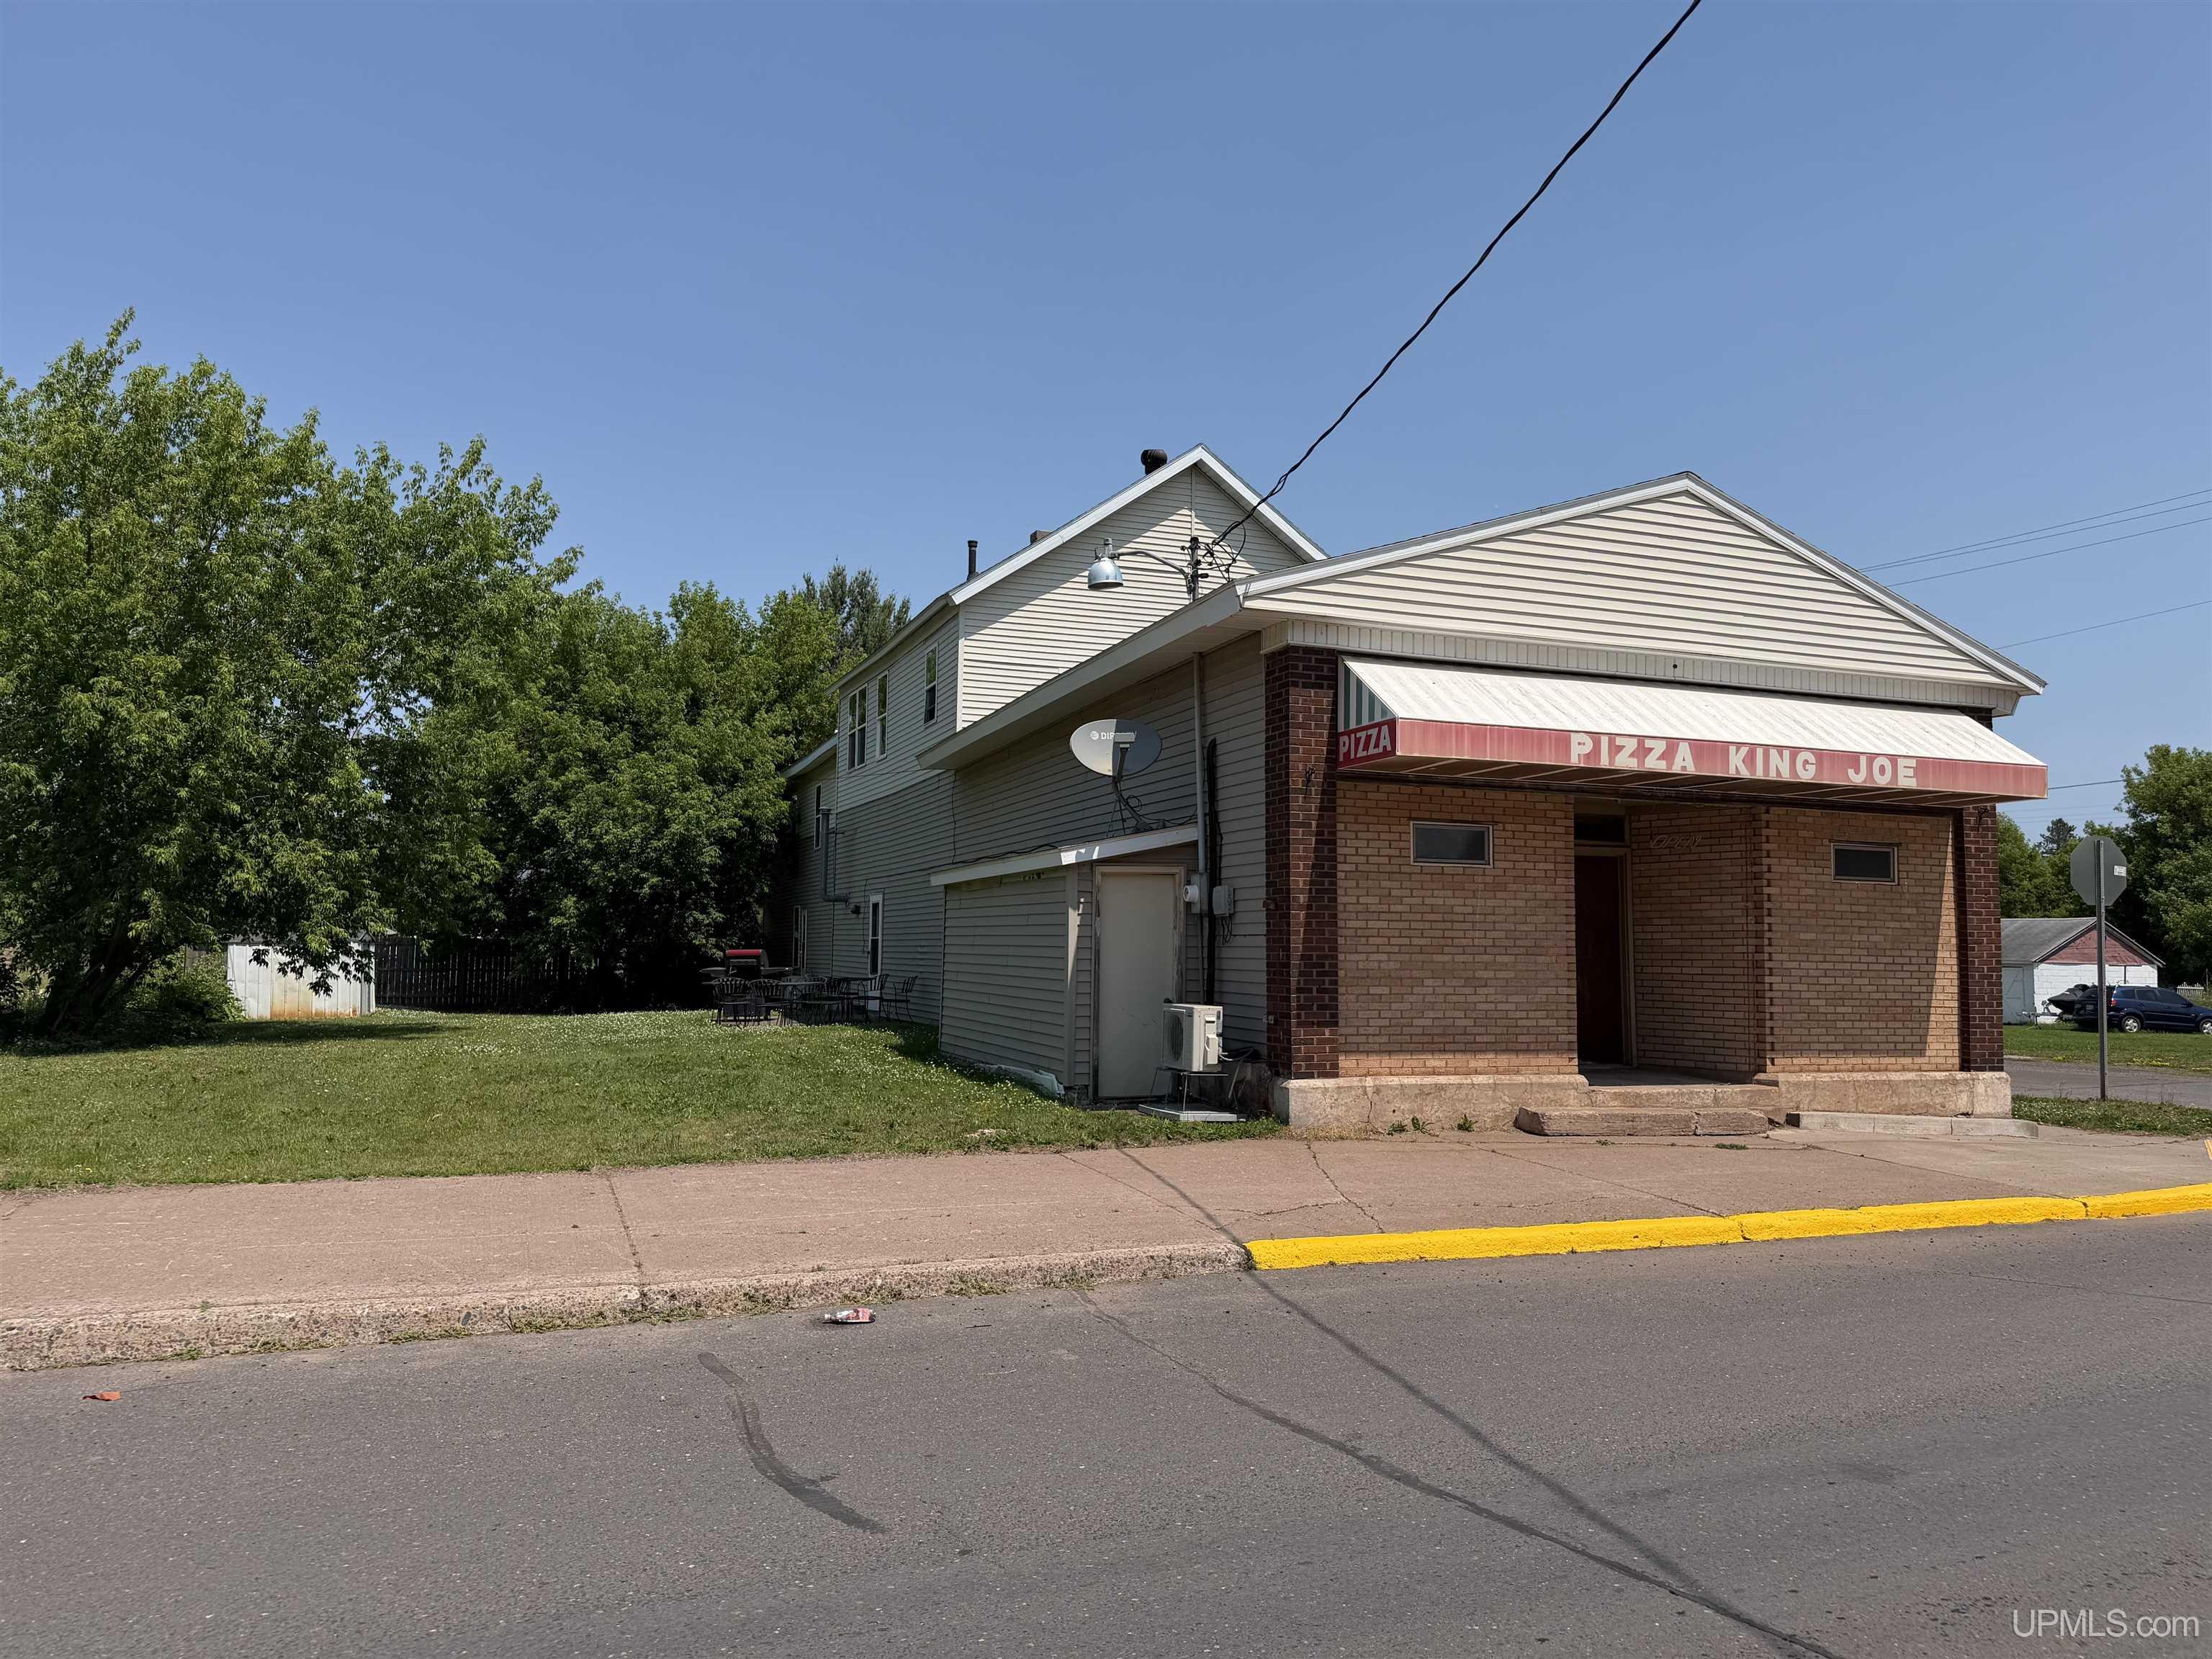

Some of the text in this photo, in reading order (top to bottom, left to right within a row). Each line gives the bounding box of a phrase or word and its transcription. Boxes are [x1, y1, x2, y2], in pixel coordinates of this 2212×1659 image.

[1339, 725, 1392, 762] PIZZA
[1570, 732, 1917, 787] PIZZA KING JOE
